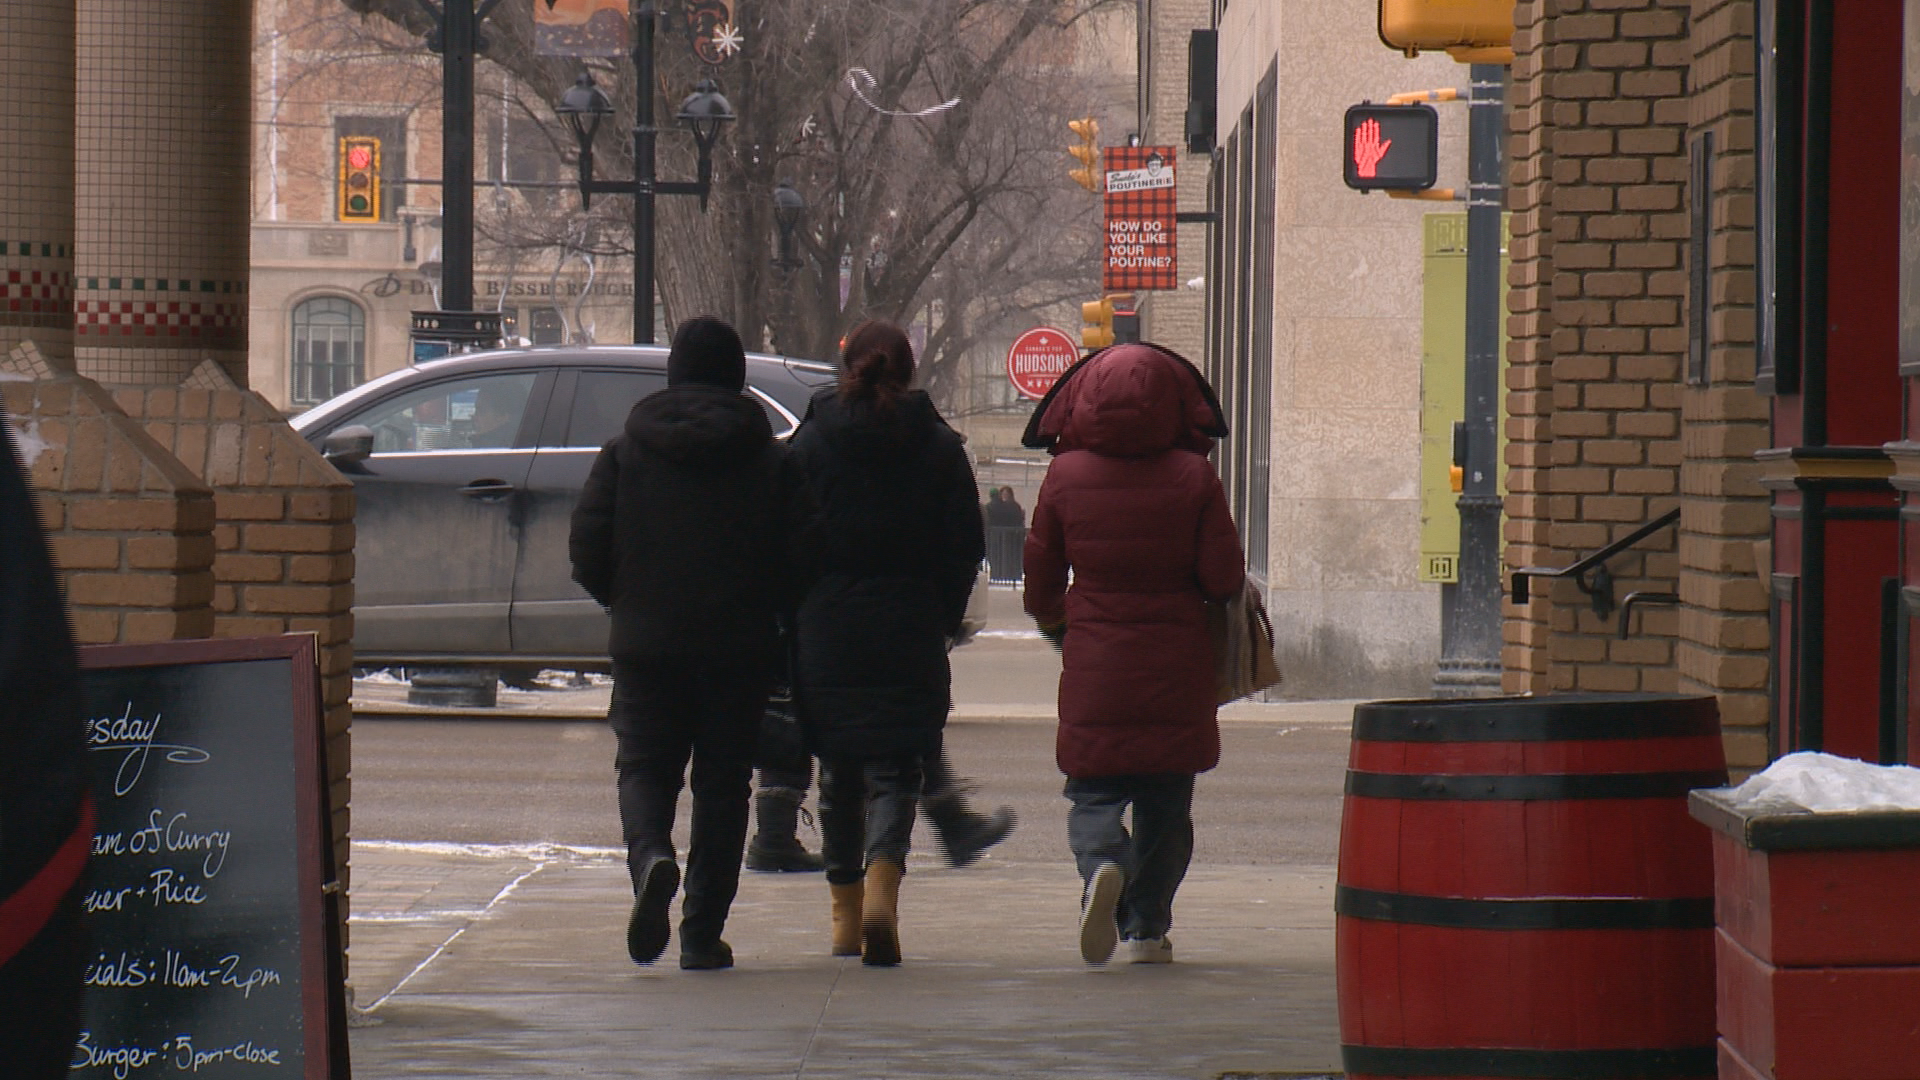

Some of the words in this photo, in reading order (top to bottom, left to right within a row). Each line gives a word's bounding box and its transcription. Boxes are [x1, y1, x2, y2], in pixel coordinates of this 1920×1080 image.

[1110, 221, 1139, 231] HOW
[1143, 221, 1162, 231] DO
[1110, 233, 1135, 243] YOU
[1139, 233, 1167, 243] LIKE
[1110, 245, 1144, 255] YOUR
[1110, 257, 1172, 267] POUTINE?
[1016, 353, 1072, 373] HUDSONS
[130, 808, 163, 854] of
[166, 812, 231, 879] Curry
[150, 869, 207, 907] Rice
